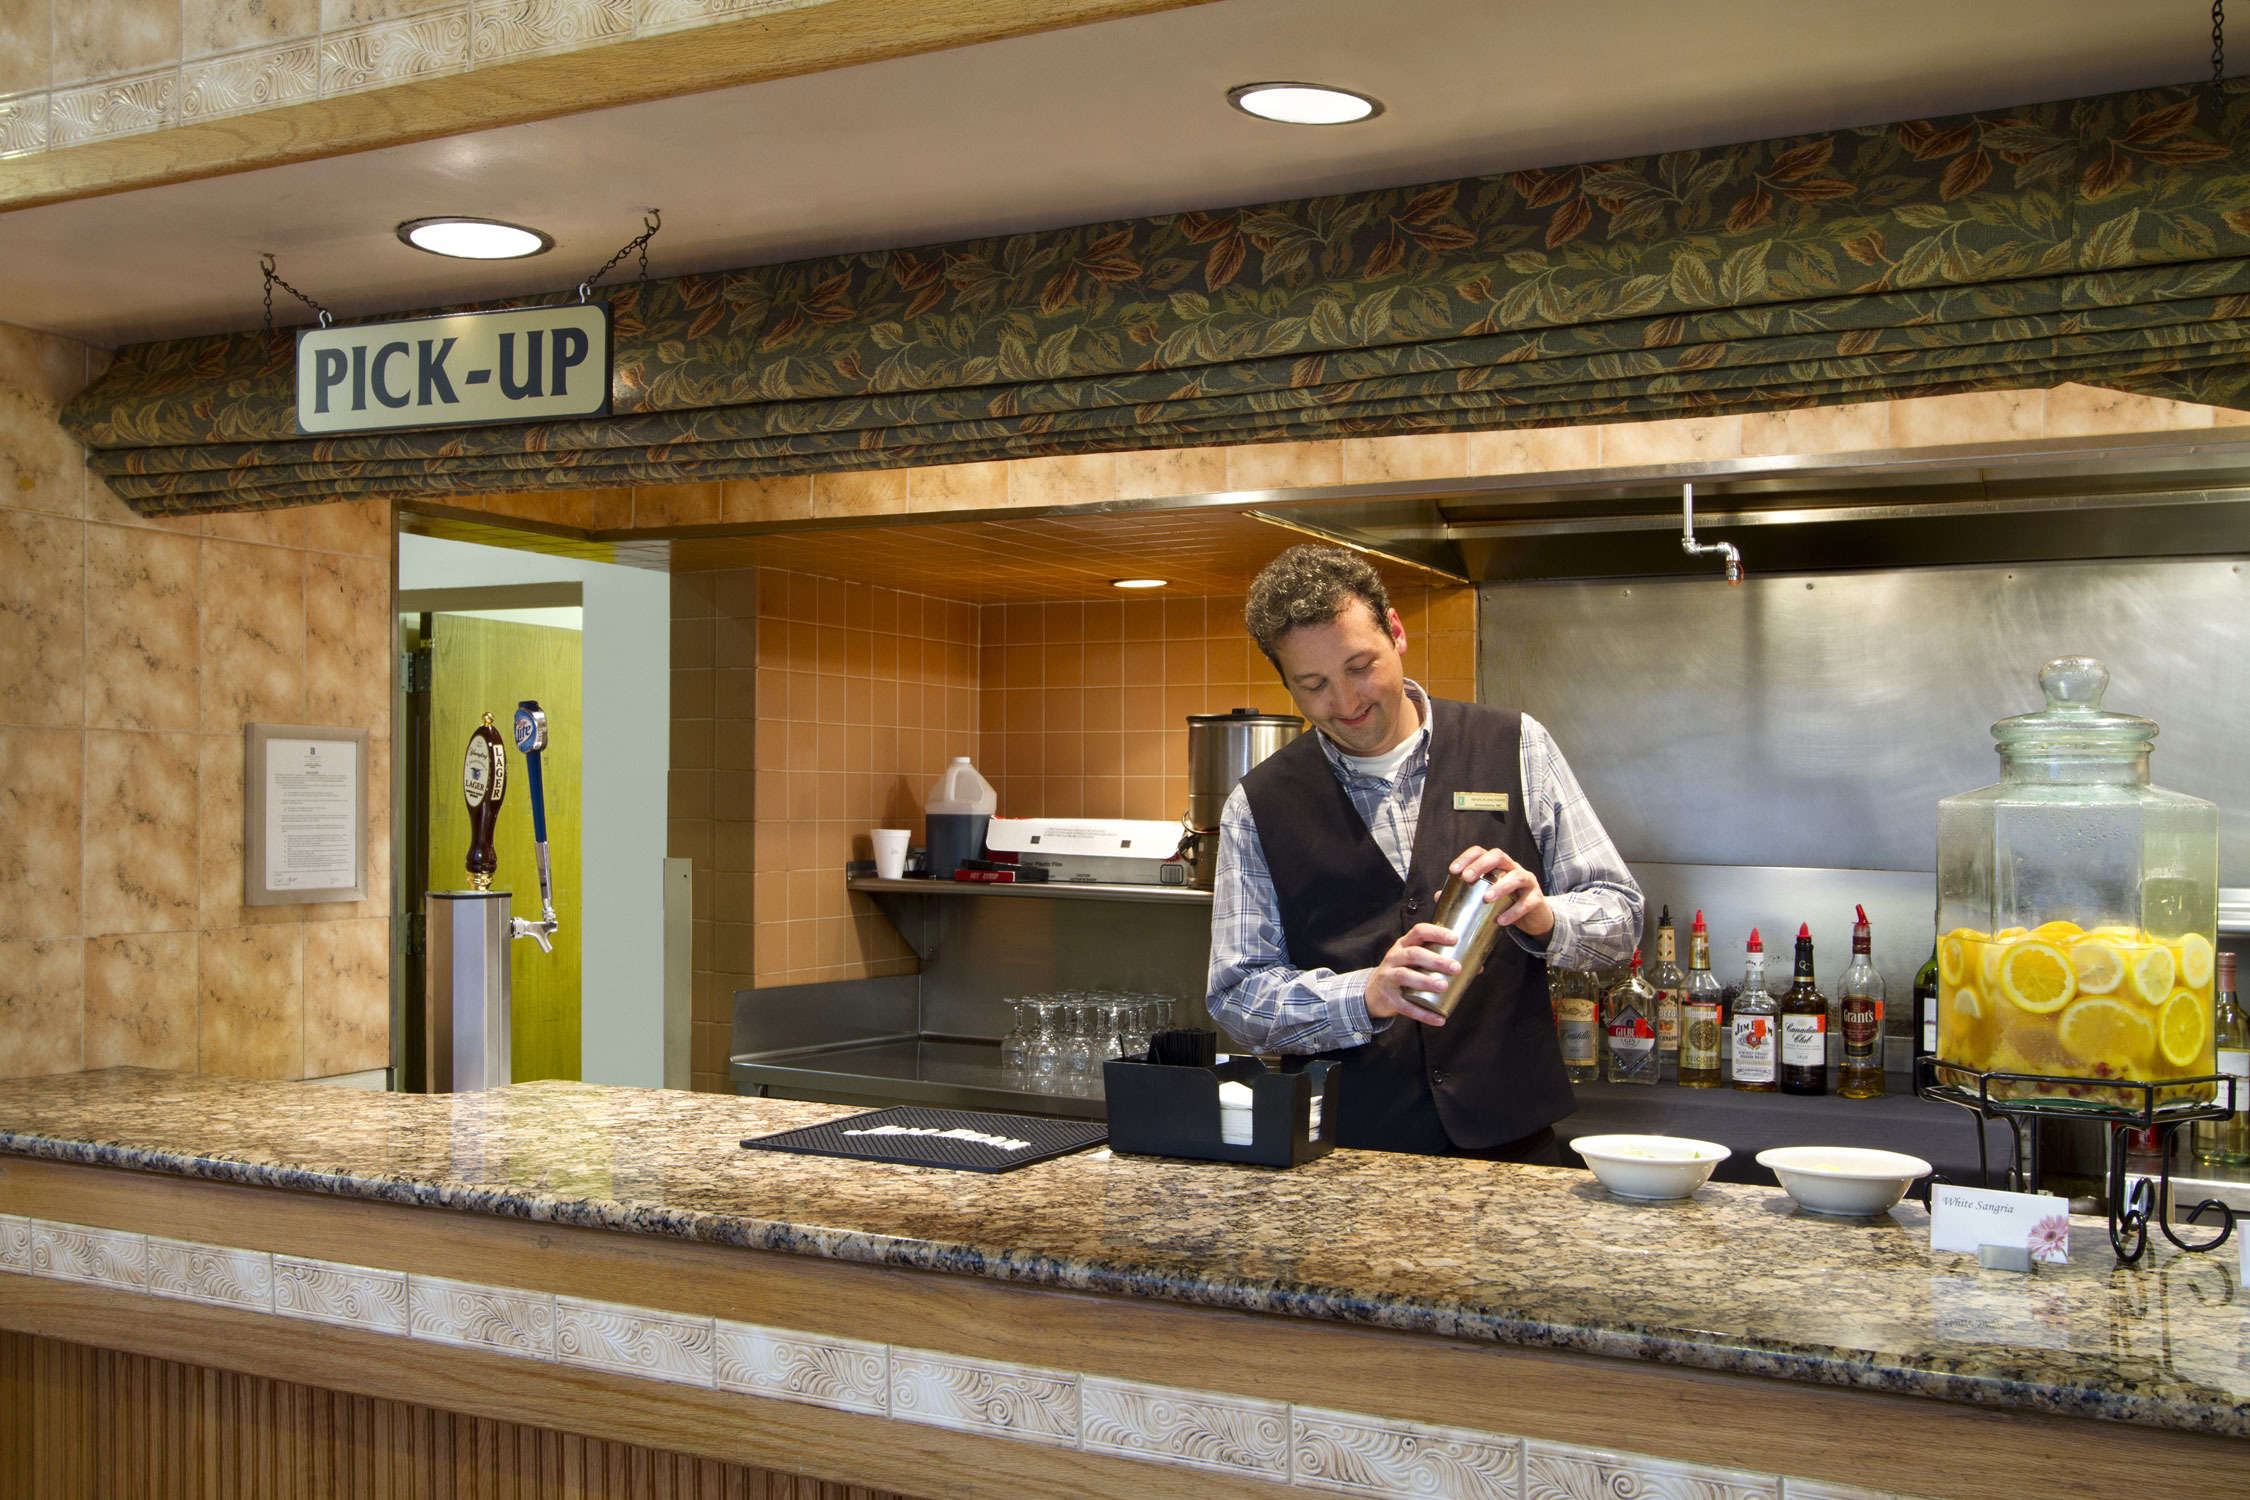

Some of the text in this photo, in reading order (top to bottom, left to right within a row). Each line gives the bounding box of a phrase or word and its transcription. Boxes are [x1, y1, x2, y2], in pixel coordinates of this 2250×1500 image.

[313, 326, 590, 414] PICK-UP
[494, 747, 503, 799] LAGER
[465, 779, 485, 792] LAGER
[1843, 1008, 1874, 1024] Grant's
[1734, 1022, 1750, 1036] JIM
[1943, 1195, 2015, 1215] White Sangria
